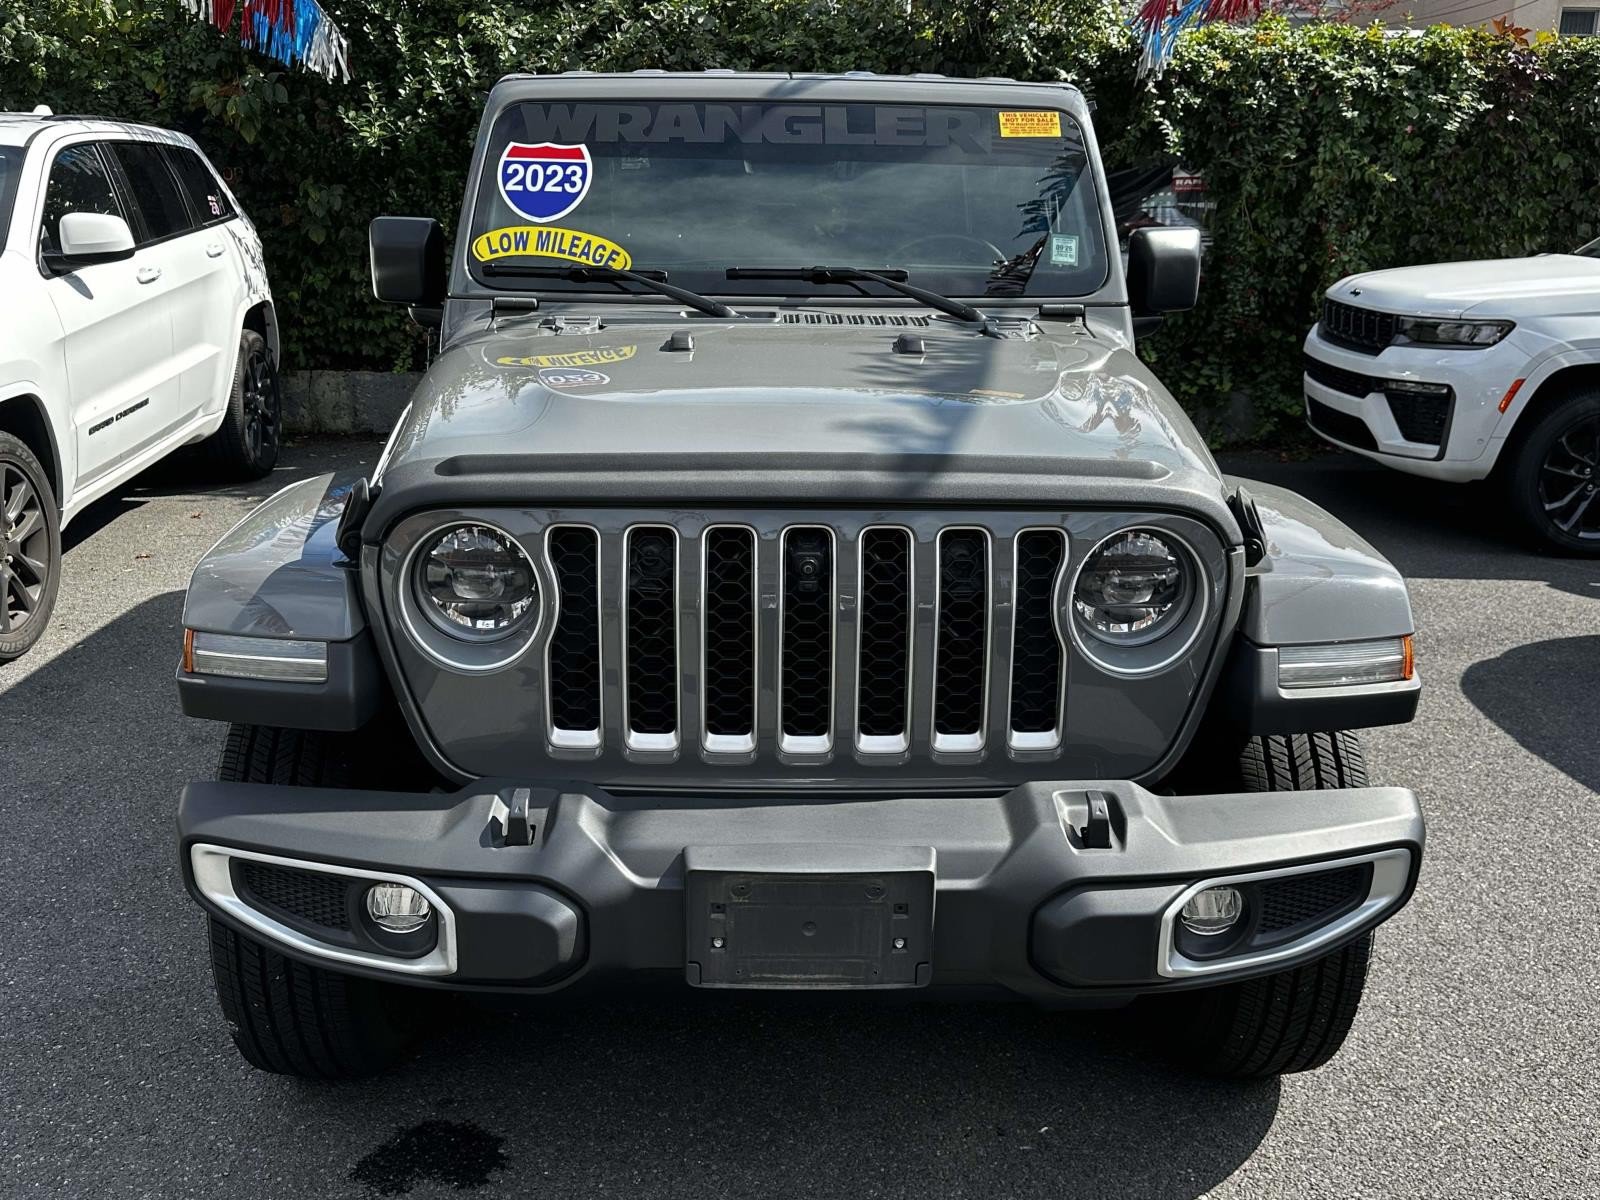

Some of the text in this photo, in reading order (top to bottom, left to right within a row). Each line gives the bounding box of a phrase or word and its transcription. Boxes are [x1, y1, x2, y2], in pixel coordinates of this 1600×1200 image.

[521, 103, 992, 153] WRANGLER
[505, 163, 583, 193] 2023
[486, 231, 621, 269] LOW MILEAGE
